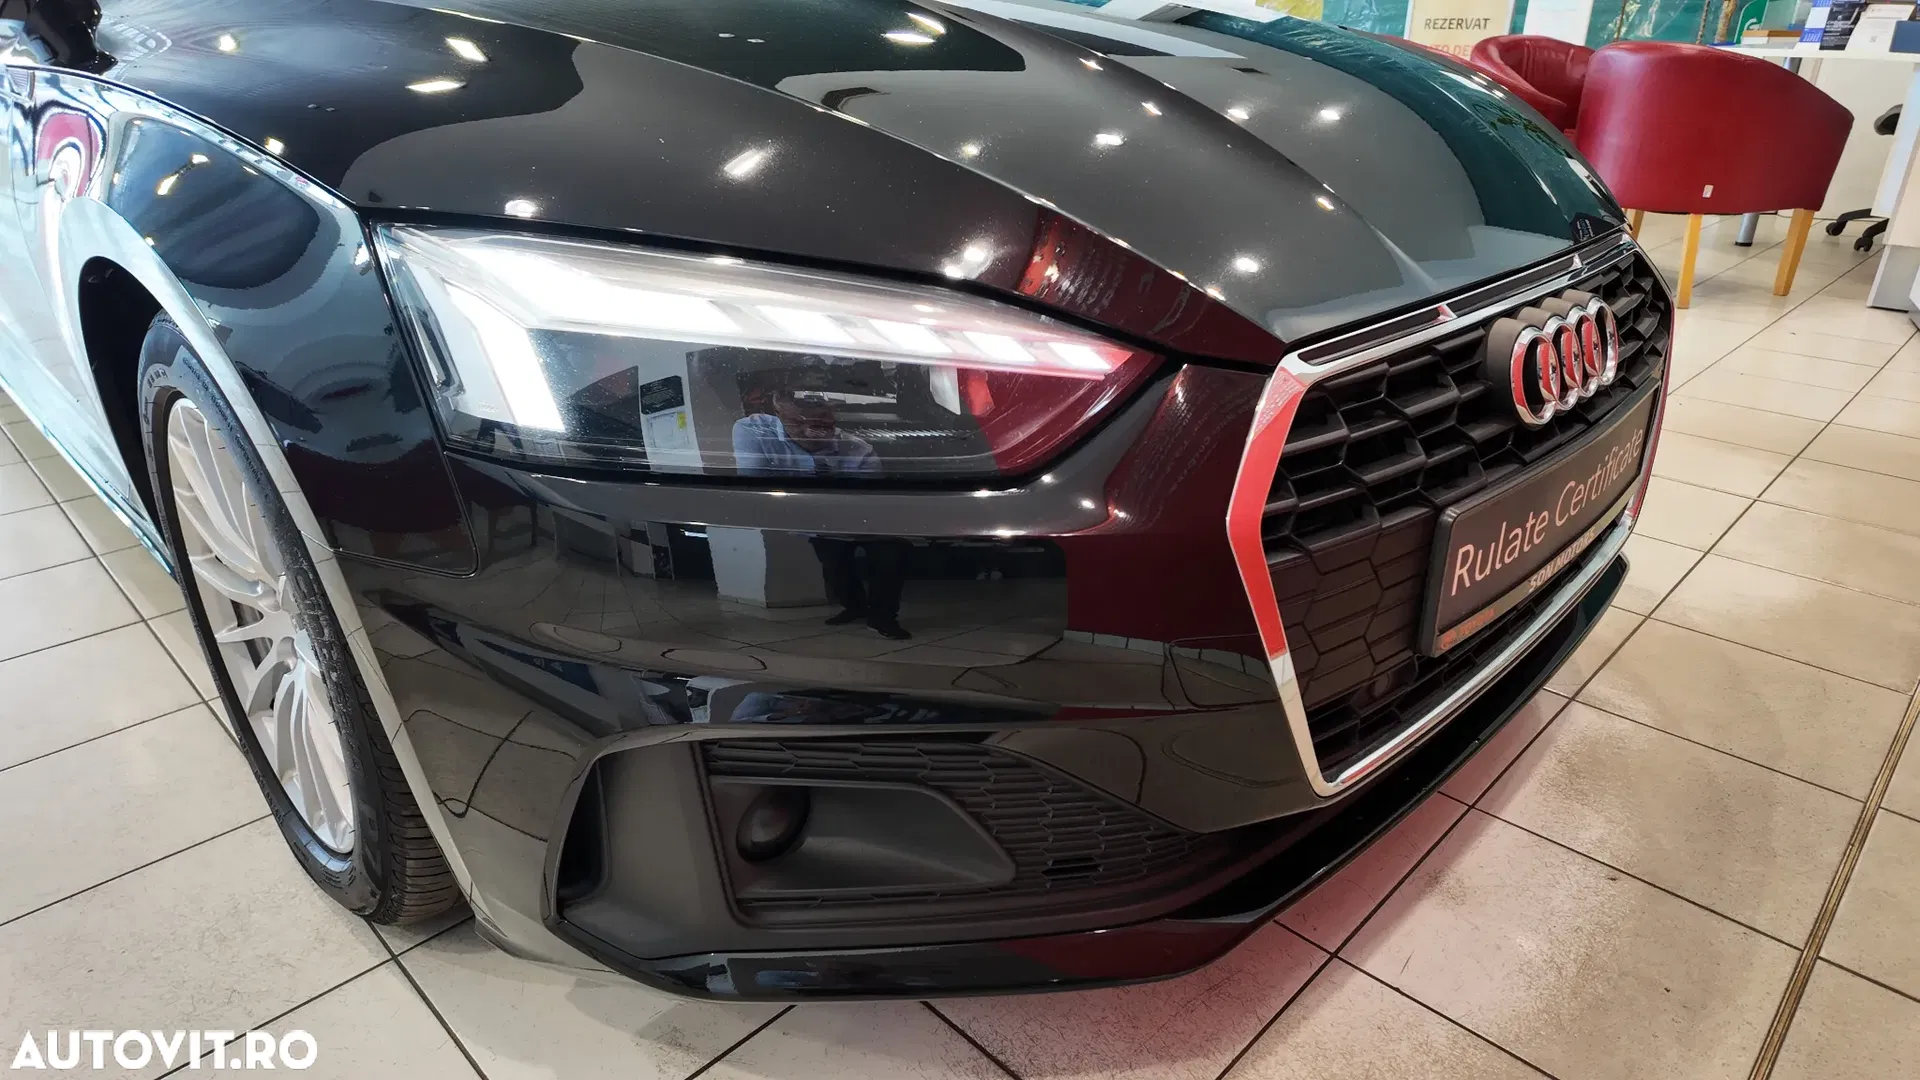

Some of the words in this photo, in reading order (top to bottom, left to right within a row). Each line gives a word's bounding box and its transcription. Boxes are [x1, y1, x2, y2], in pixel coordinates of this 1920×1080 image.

[1423, 18, 1490, 30] REZERVAT
[1451, 510, 1549, 597] Rulate
[1555, 428, 1644, 527] Certificate
